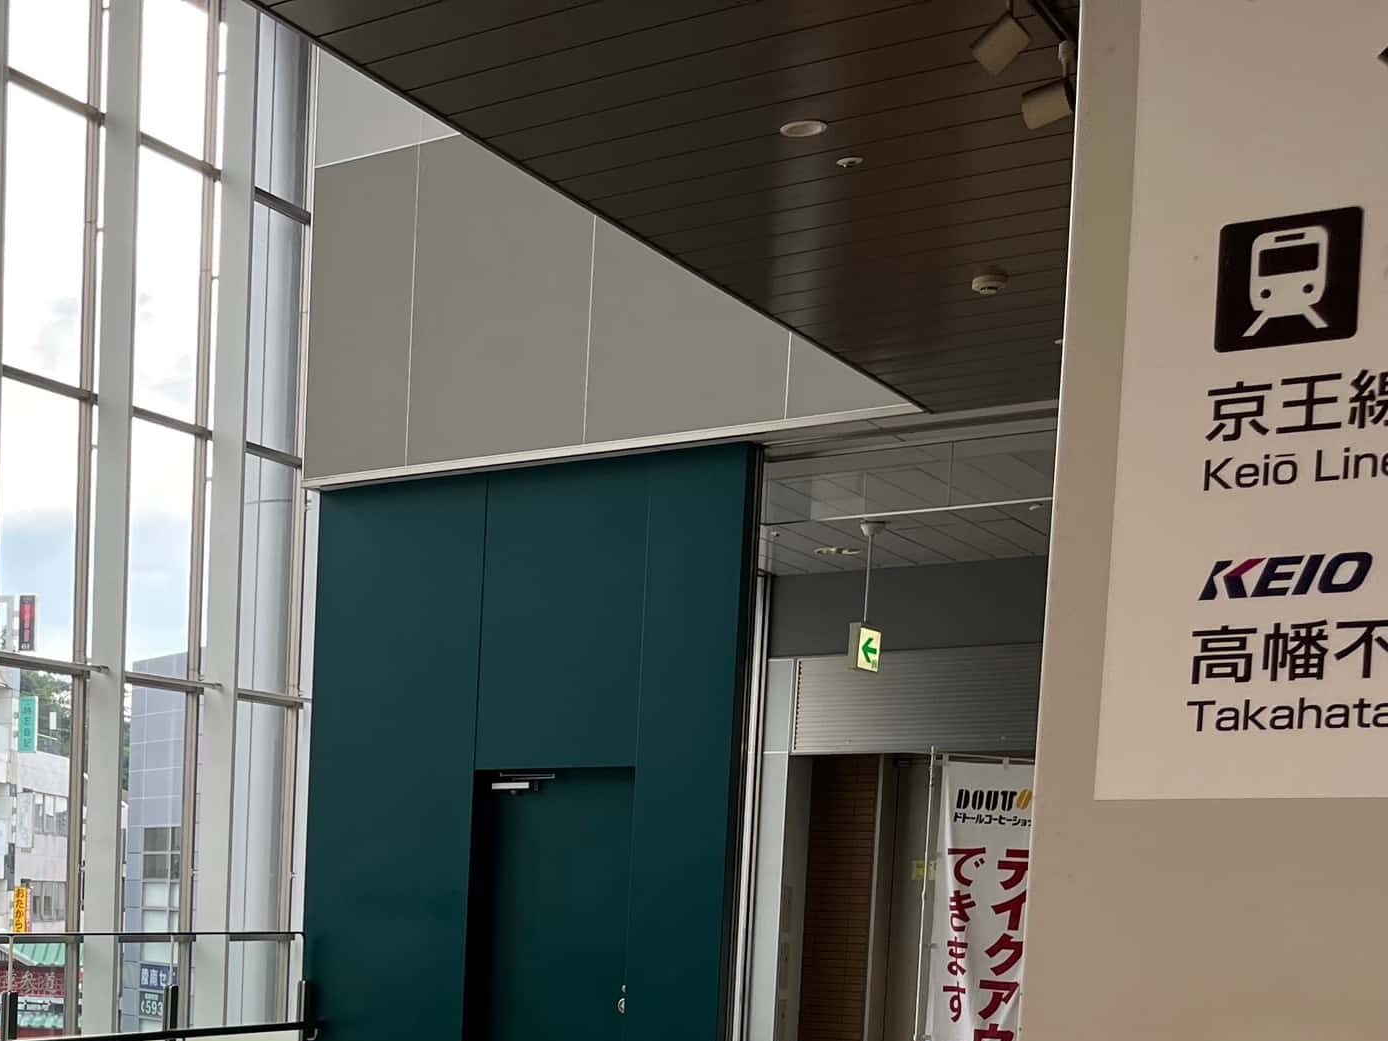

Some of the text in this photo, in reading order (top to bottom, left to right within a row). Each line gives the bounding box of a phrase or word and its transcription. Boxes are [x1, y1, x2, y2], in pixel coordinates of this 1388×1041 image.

[1205, 368, 1388, 441] 京王線
[1203, 452, 1299, 491] Keiō
[1197, 551, 1374, 601] KEIO
[1190, 619, 1388, 685] 高幡不
[15, 888, 25, 932] おたから
[942, 847, 986, 1023] できます
